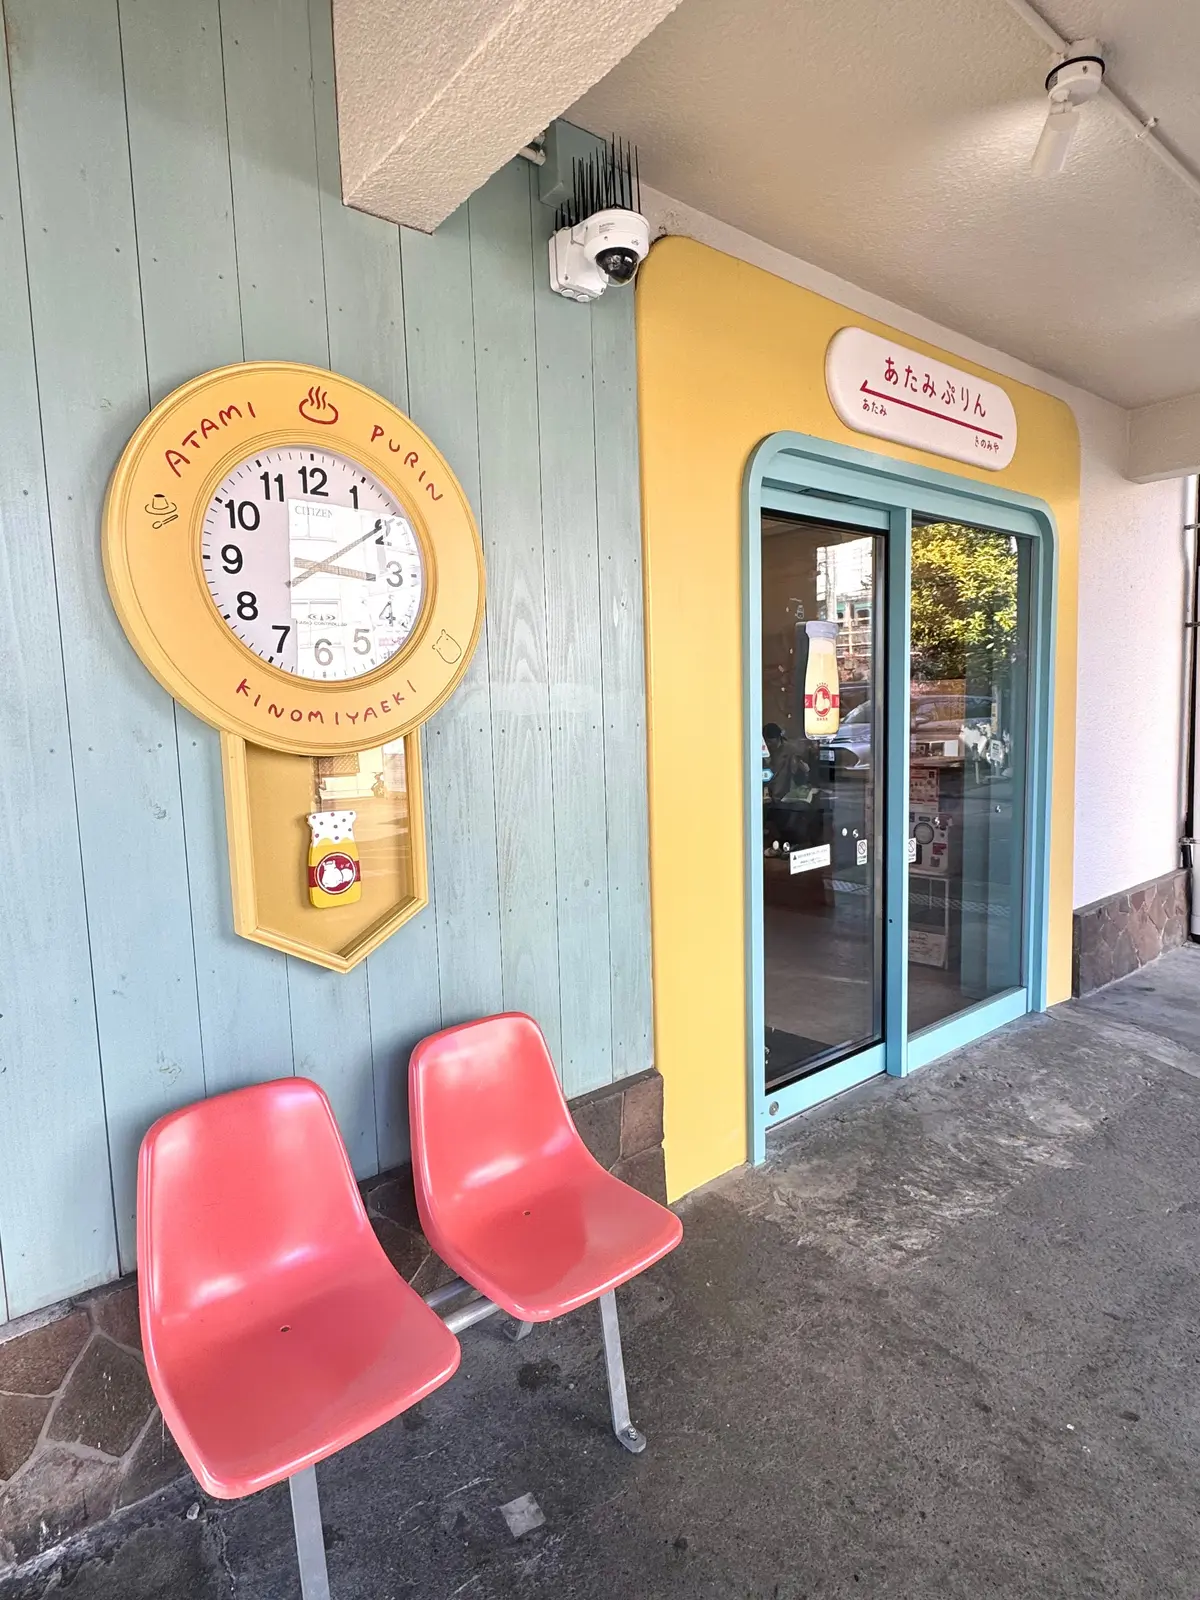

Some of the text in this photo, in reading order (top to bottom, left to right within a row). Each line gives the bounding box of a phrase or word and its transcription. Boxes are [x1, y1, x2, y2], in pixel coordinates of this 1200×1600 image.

[884, 356, 987, 418] あたみぷりん
[862, 398, 888, 417] あたみ
[164, 401, 257, 478] ATAMI
[974, 435, 1000, 454] きのみや
[370, 425, 444, 502] PURIN
[260, 471, 285, 502] 11
[298, 465, 329, 497] 12
[294, 505, 333, 519] CITIZEN
[349, 485, 359, 511] 1
[224, 499, 260, 531] 10
[221, 544, 243, 575] 9
[386, 560, 404, 588] 3
[236, 591, 259, 621] 8
[379, 601, 396, 627] 4
[271, 625, 291, 653] 7
[314, 638, 334, 666] 6
[353, 628, 371, 656] 5
[235, 678, 417, 726] KINOMIYAEKI
